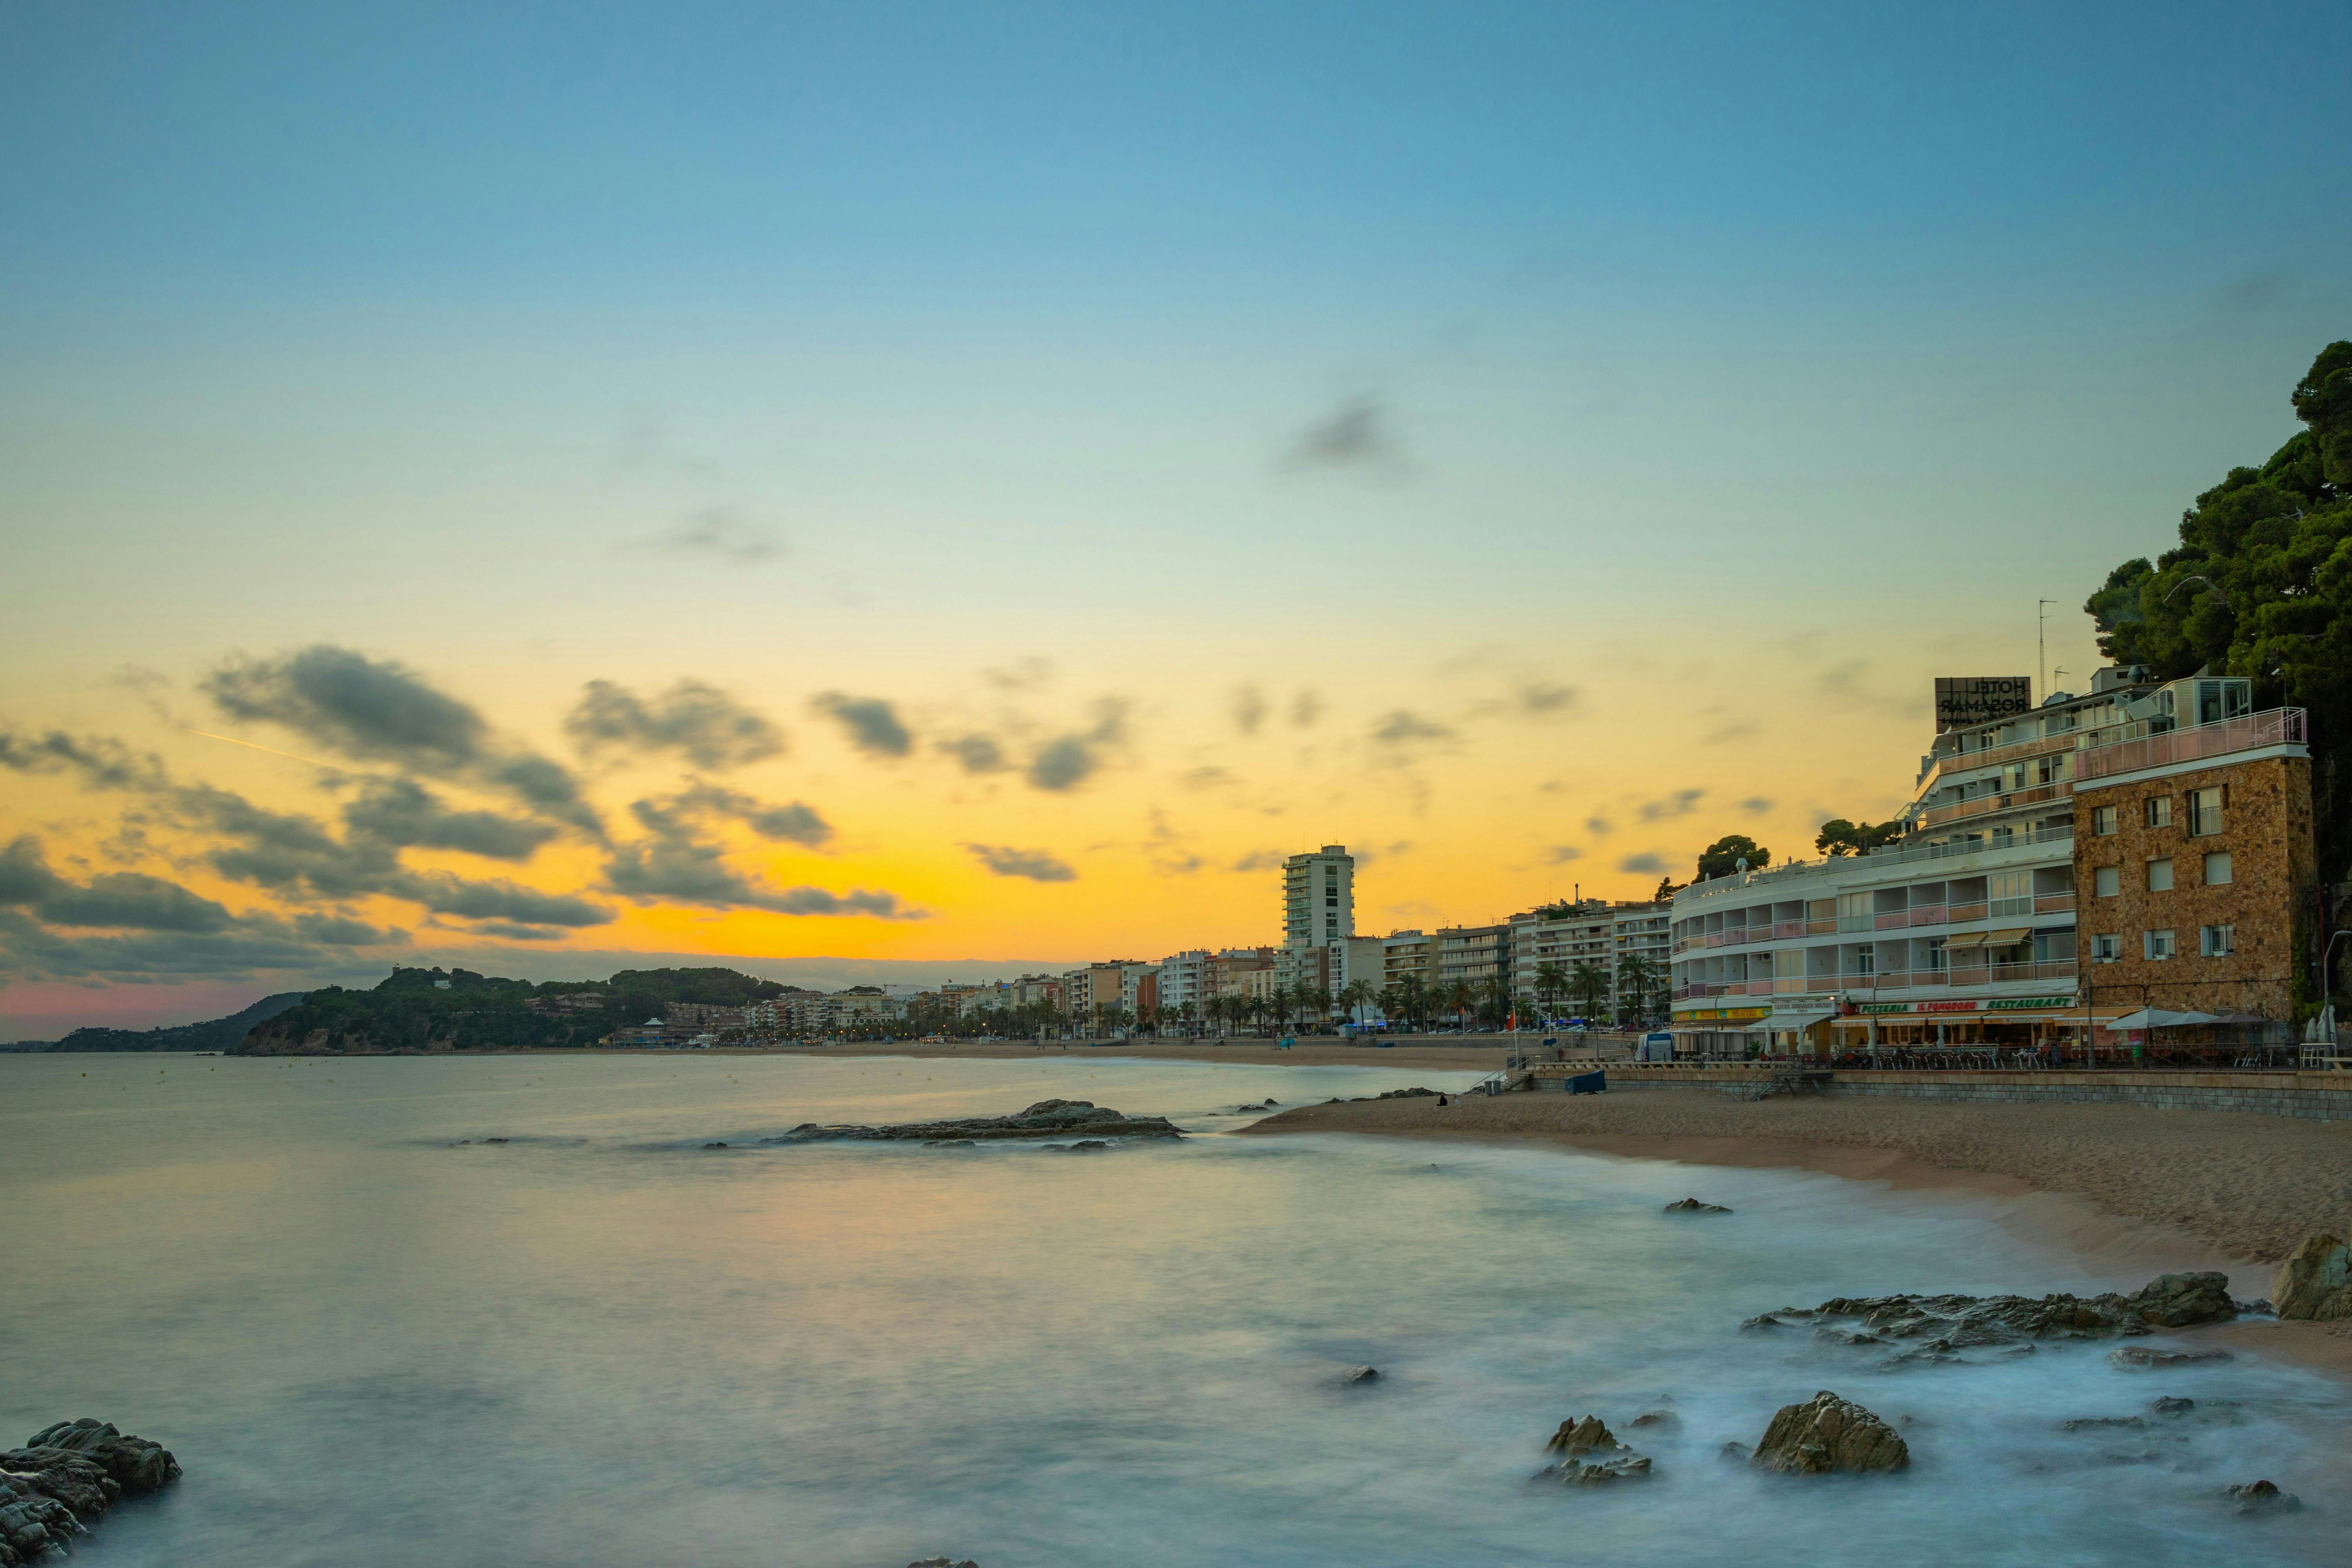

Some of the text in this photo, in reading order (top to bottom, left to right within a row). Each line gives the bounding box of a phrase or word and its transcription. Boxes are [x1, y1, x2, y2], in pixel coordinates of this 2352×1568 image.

[1862, 1004, 1908, 1013] PIZZERIA
[1927, 1002, 1976, 1011] POMODORO
[1986, 997, 2071, 1009] RESTAURANT
